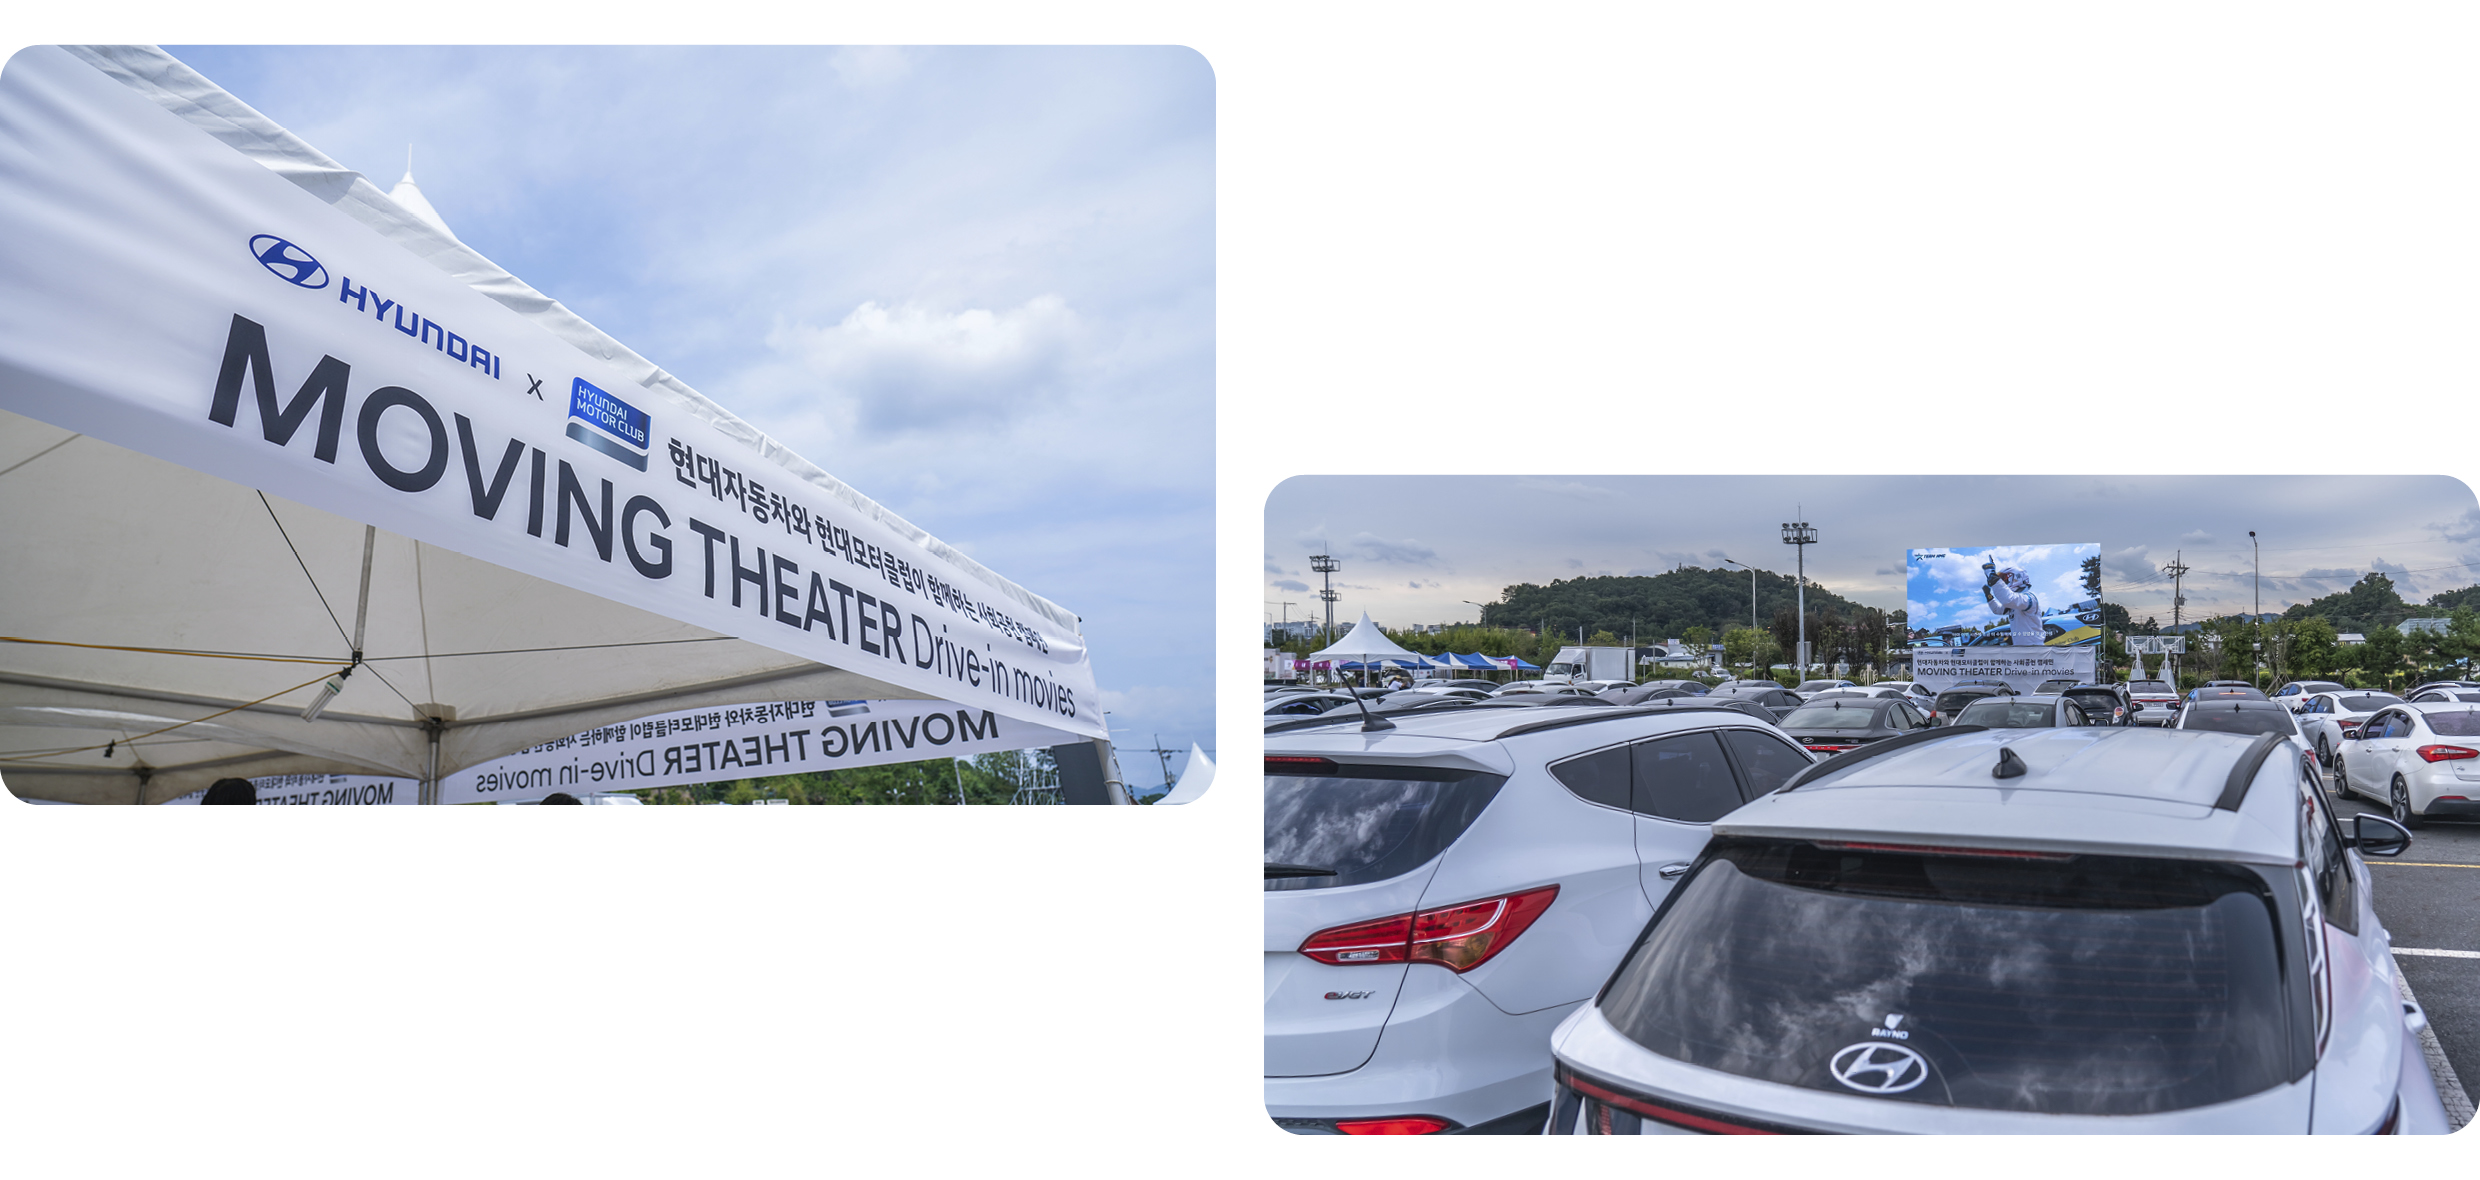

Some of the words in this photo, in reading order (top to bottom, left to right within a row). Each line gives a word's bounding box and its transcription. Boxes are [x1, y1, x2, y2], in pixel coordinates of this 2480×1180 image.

[339, 276, 501, 380] HYUNDAI
[576, 397, 617, 429] MOTOR
[618, 420, 645, 442] CLUB
[578, 385, 628, 420] HYUNDAI
[208, 313, 673, 580] MOVING
[690, 517, 907, 664] THEATER
[911, 613, 1009, 697] Drive-in
[1013, 667, 1076, 718] movies
[668, 437, 812, 544] 현대자동차와
[815, 514, 929, 600] 현대모터클럽이
[927, 573, 980, 623] 함께하는
[1917, 667, 1957, 676] MOVING
[1958, 667, 2002, 676] THEATER
[2004, 667, 2040, 676] Drive-in
[2041, 667, 2075, 676] movies
[1871, 1027, 1909, 1040] RAYNO
